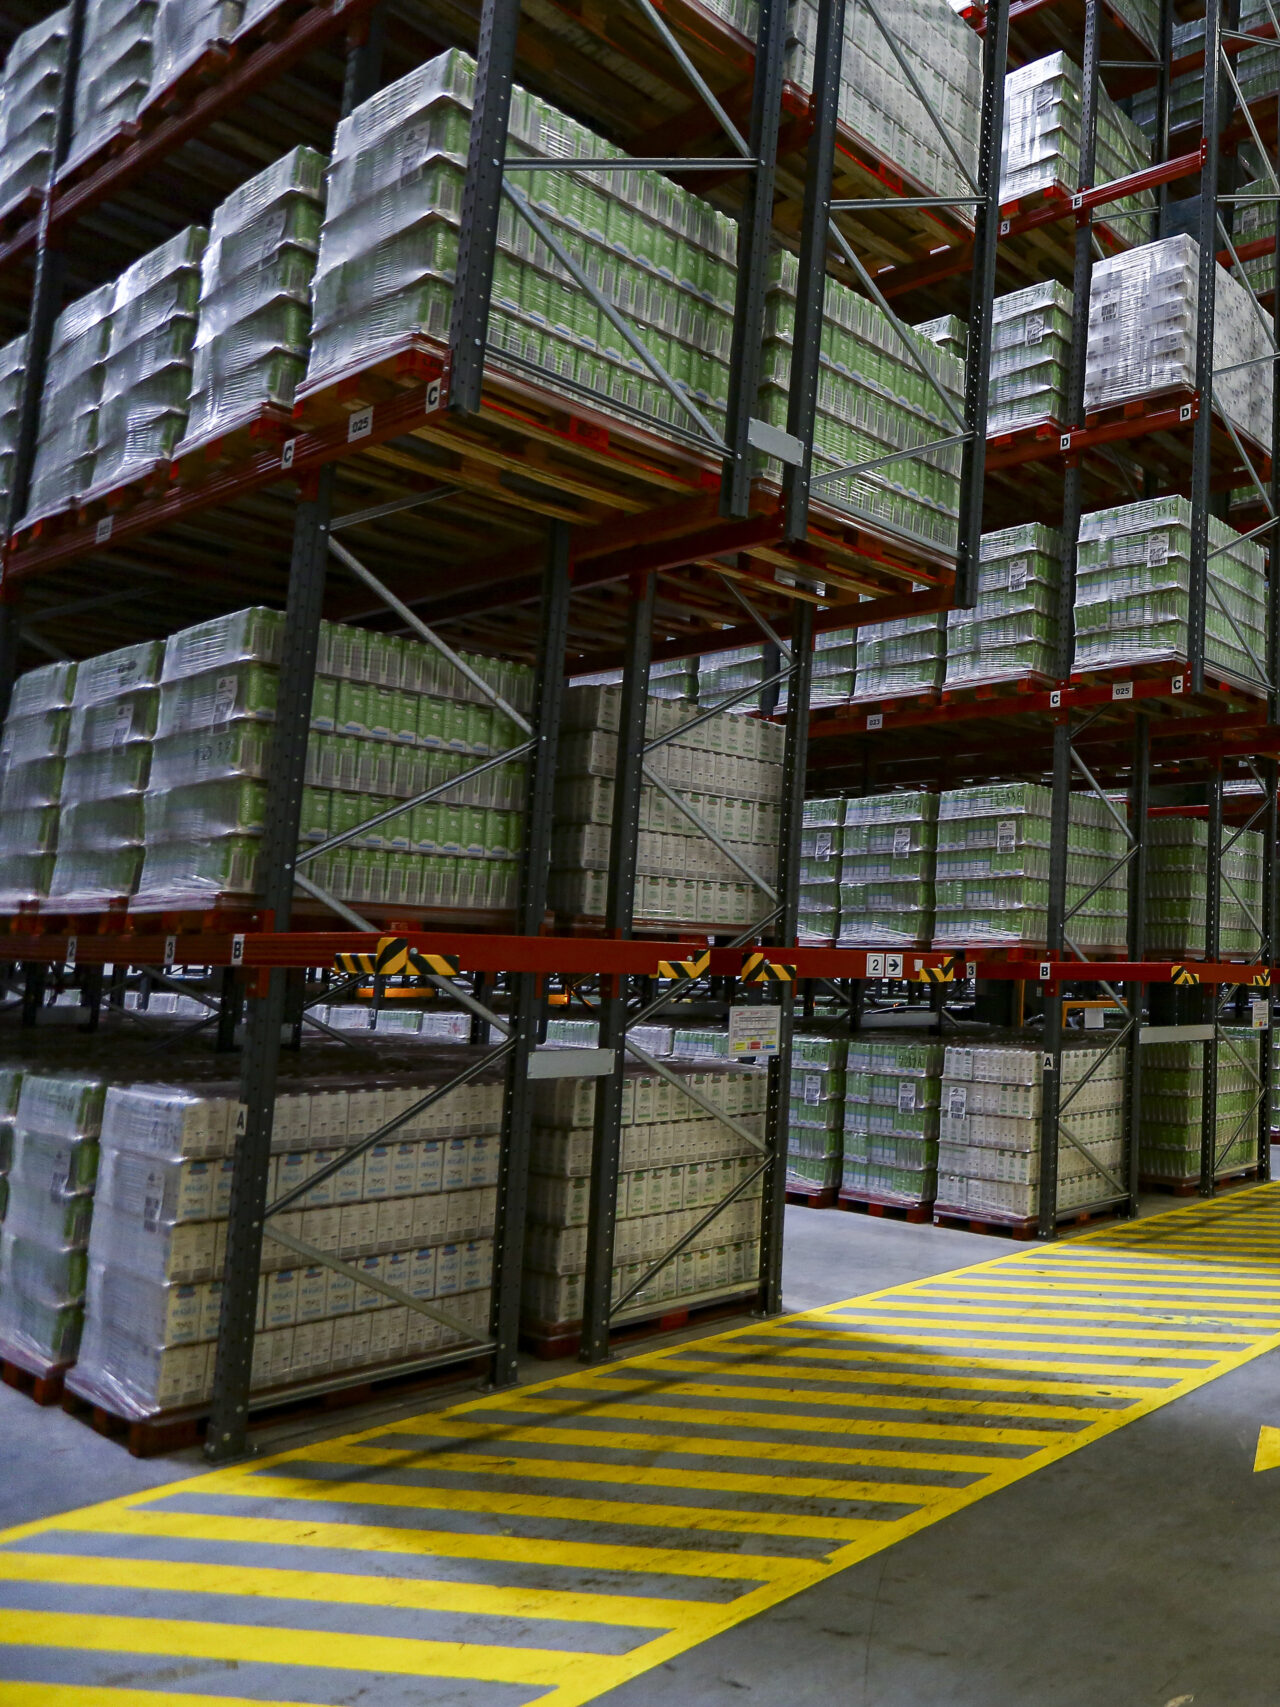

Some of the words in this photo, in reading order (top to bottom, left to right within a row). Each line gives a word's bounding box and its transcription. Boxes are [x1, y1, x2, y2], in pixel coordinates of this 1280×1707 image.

[1074, 196, 1081, 207] E
[1002, 223, 1008, 232] 3
[428, 386, 438, 405] C
[1181, 407, 1190, 418] D
[352, 417, 369, 433] 025
[1061, 437, 1069, 447] D
[284, 446, 292, 463] C
[1173, 679, 1181, 690] C
[1115, 687, 1130, 696] 025
[1051, 694, 1059, 705] C
[69, 941, 75, 958] 2
[167, 942, 173, 958] 3
[233, 941, 241, 959] B
[872, 959, 879, 971] 2
[968, 965, 974, 976] 3
[1041, 966, 1048, 976] B
[1044, 1057, 1052, 1067] A
[237, 1111, 244, 1129] A
